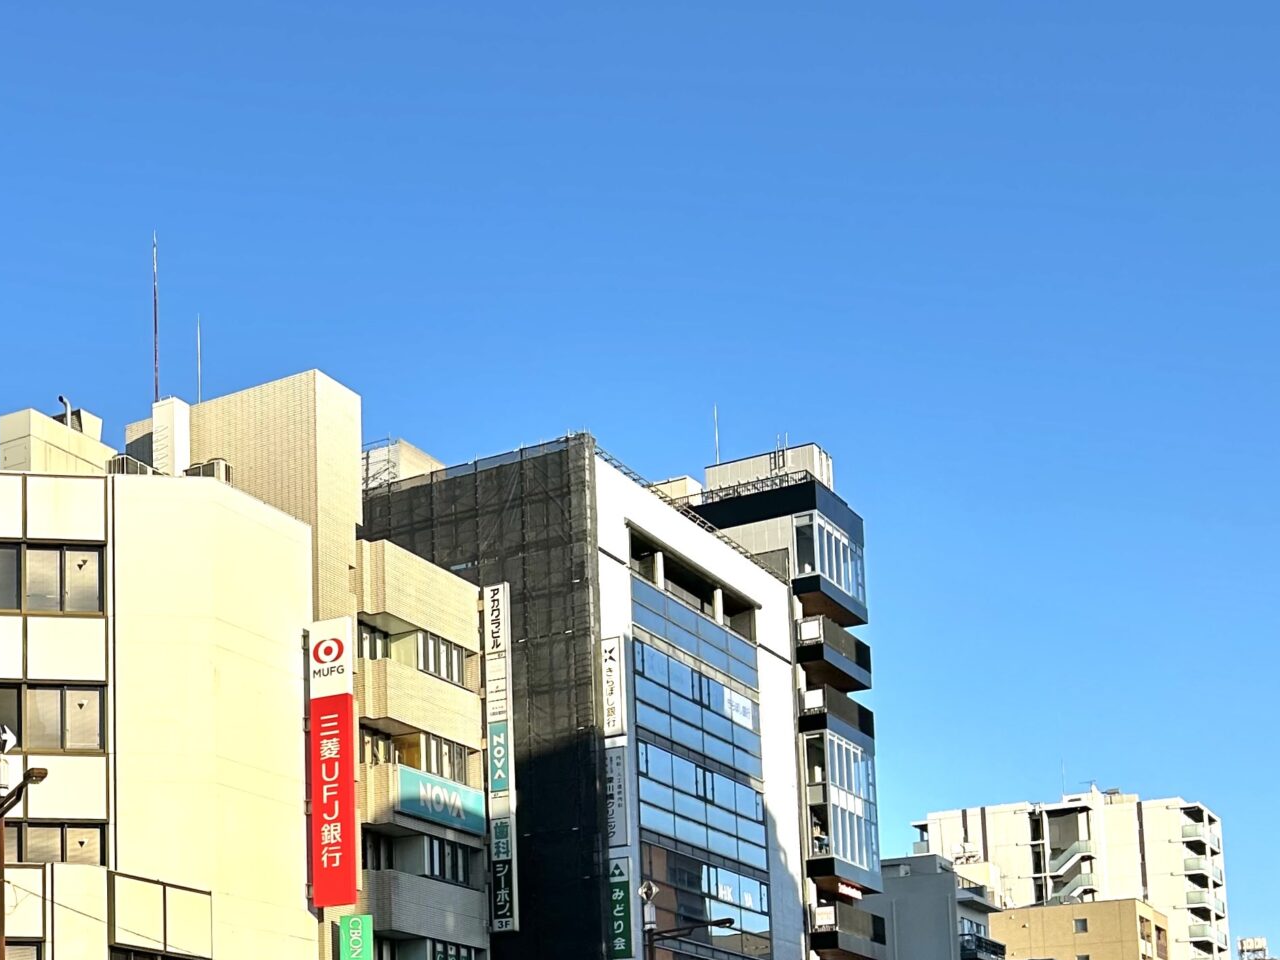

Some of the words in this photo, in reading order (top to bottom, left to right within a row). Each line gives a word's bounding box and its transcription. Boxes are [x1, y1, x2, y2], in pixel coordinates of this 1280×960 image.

[312, 665, 345, 678] MUFG
[492, 733, 506, 779] NOVA
[319, 713, 342, 868] 三菱UFJ銀行
[419, 780, 466, 820] NOVA
[494, 821, 510, 858] 歯科
[349, 917, 363, 958] CBON
[497, 920, 511, 929] 3F
[612, 888, 626, 950] みどり会
